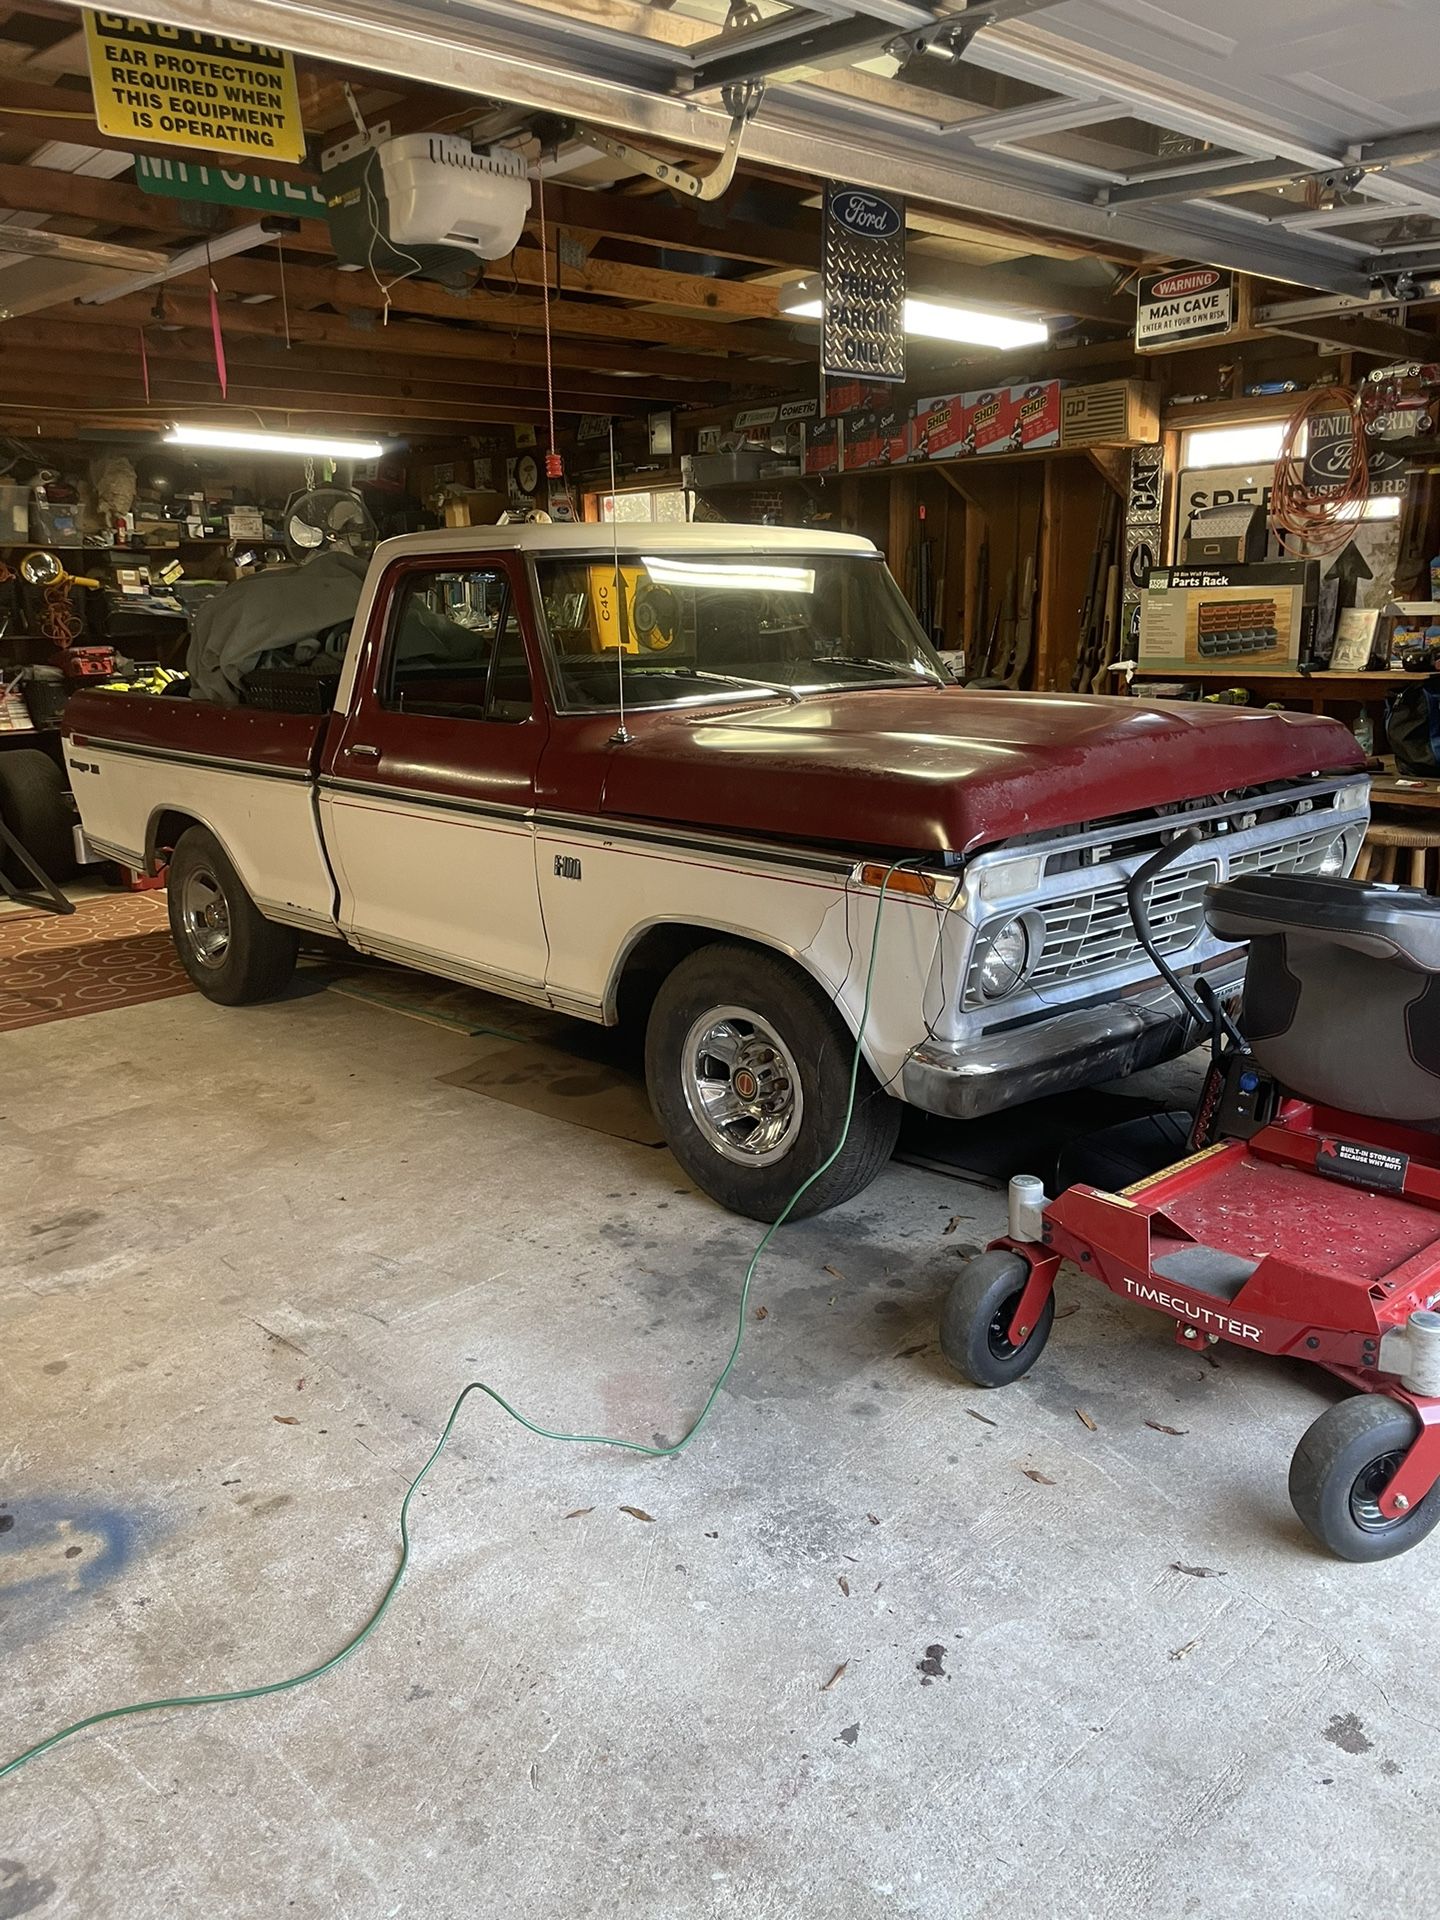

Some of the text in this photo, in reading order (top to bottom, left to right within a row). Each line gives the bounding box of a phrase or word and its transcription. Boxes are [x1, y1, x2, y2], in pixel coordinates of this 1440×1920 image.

[104, 45, 283, 90] EAR PROTECTION
[111, 67, 282, 109] REQUIRED WHEN
[112, 88, 285, 129] THIS EQUIPMENT
[132, 111, 274, 147] IS OPERATING
[844, 196, 887, 231] Ford
[1159, 273, 1212, 295] WARNING
[1150, 295, 1219, 320] MAN CAVE
[1142, 309, 1226, 333] ENTER AT YOUR OWN RISK
[845, 338, 885, 364] ONLY
[974, 402, 1000, 424] SHOP
[1021, 396, 1048, 417] SHOP
[927, 409, 951, 429] SHOP
[1310, 415, 1352, 438] GENUI
[1132, 462, 1160, 511] CAT
[1369, 478, 1407, 495] ERE
[1172, 575, 1229, 587] Parts Rack
[599, 586, 611, 621] C4C
[1339, 1152, 1402, 1171] BECAUSE WHY NOT?
[1340, 1145, 1402, 1165] BUILT-IN STORAGE.
[1123, 1277, 1260, 1343] TIMECUTTER
